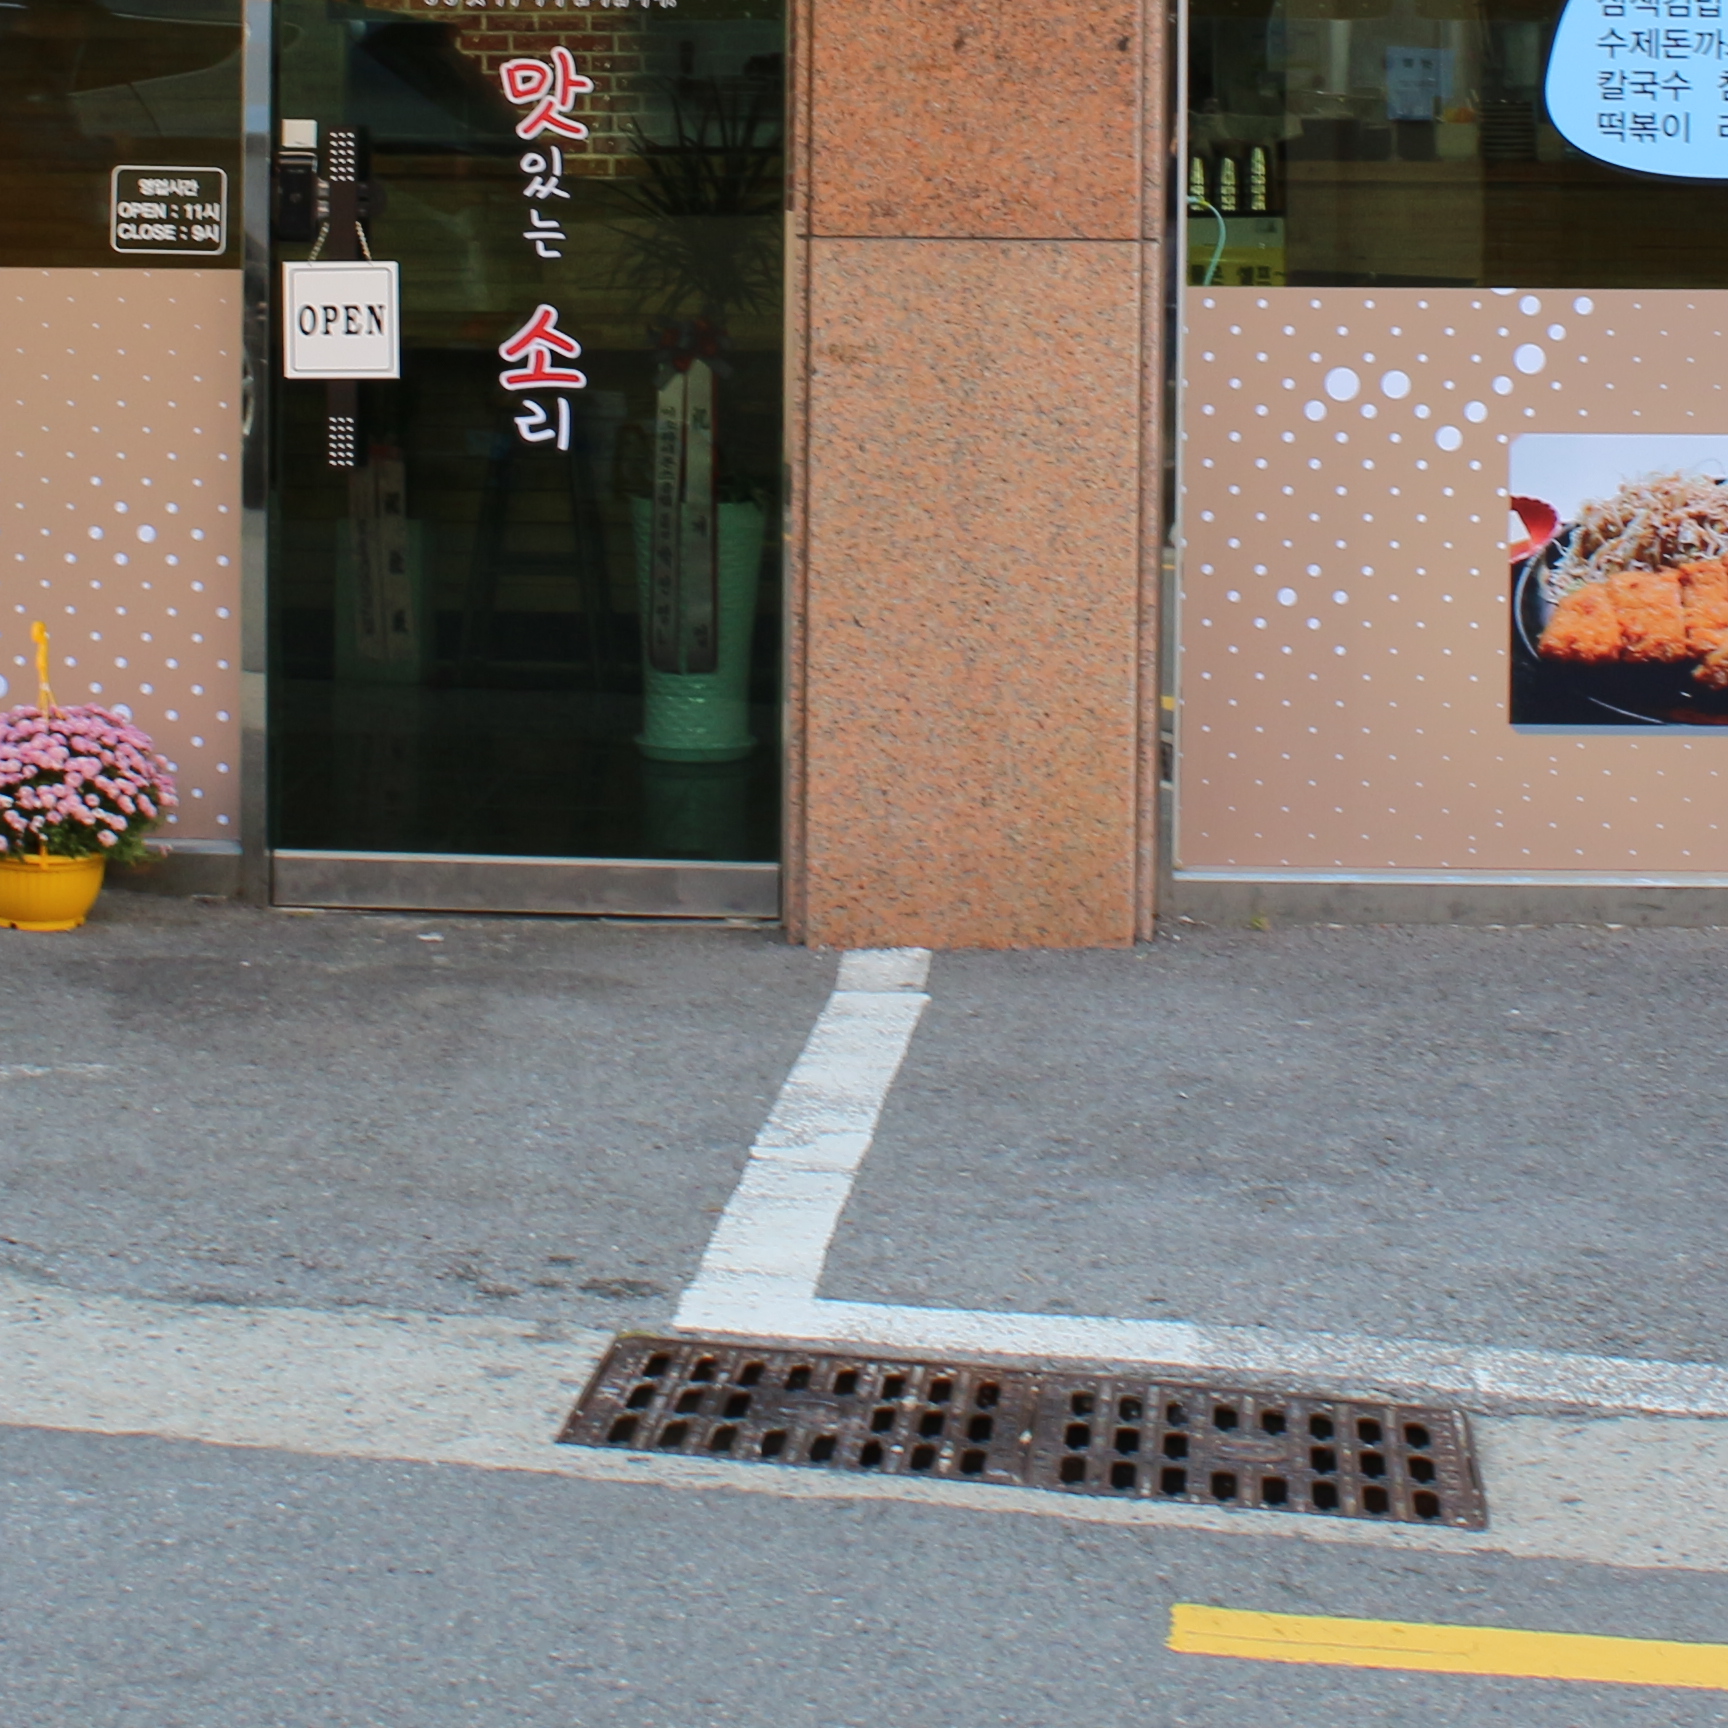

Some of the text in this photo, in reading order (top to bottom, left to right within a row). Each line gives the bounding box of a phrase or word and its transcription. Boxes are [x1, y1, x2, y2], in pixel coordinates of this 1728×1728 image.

[1596, 70, 1693, 102] 칼국수
[1596, 112, 1693, 144] 떡볶이
[117, 202, 167, 219] OPEN
[183, 203, 220, 222] 11시
[117, 223, 177, 241] CLOSE
[191, 224, 220, 243] 9시
[298, 303, 387, 338] OPEN
[499, 303, 587, 451] 소리
